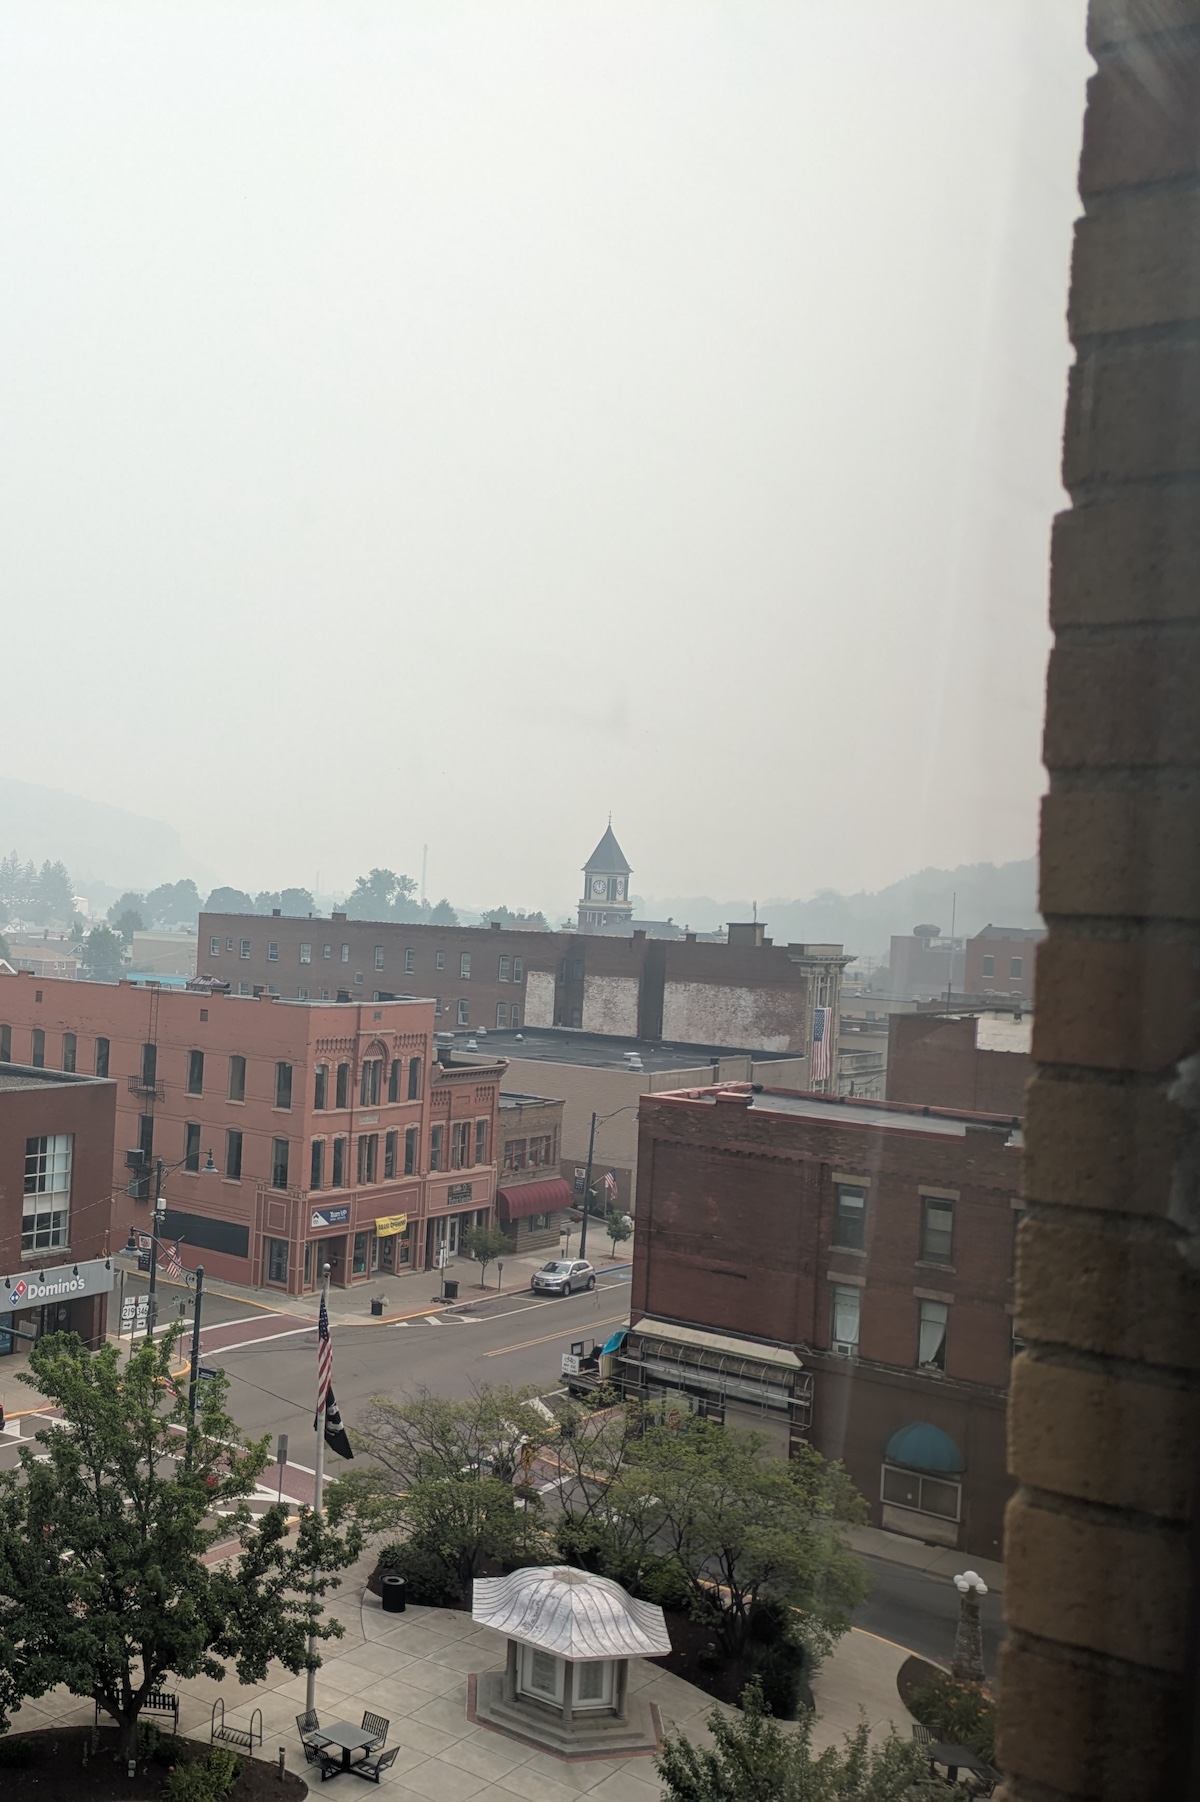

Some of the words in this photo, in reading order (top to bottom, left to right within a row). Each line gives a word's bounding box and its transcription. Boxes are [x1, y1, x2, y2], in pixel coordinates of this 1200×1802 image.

[27, 1275, 85, 1300] Domino's
[123, 1307, 135, 1316] 219
[137, 1307, 148, 1316] 346
